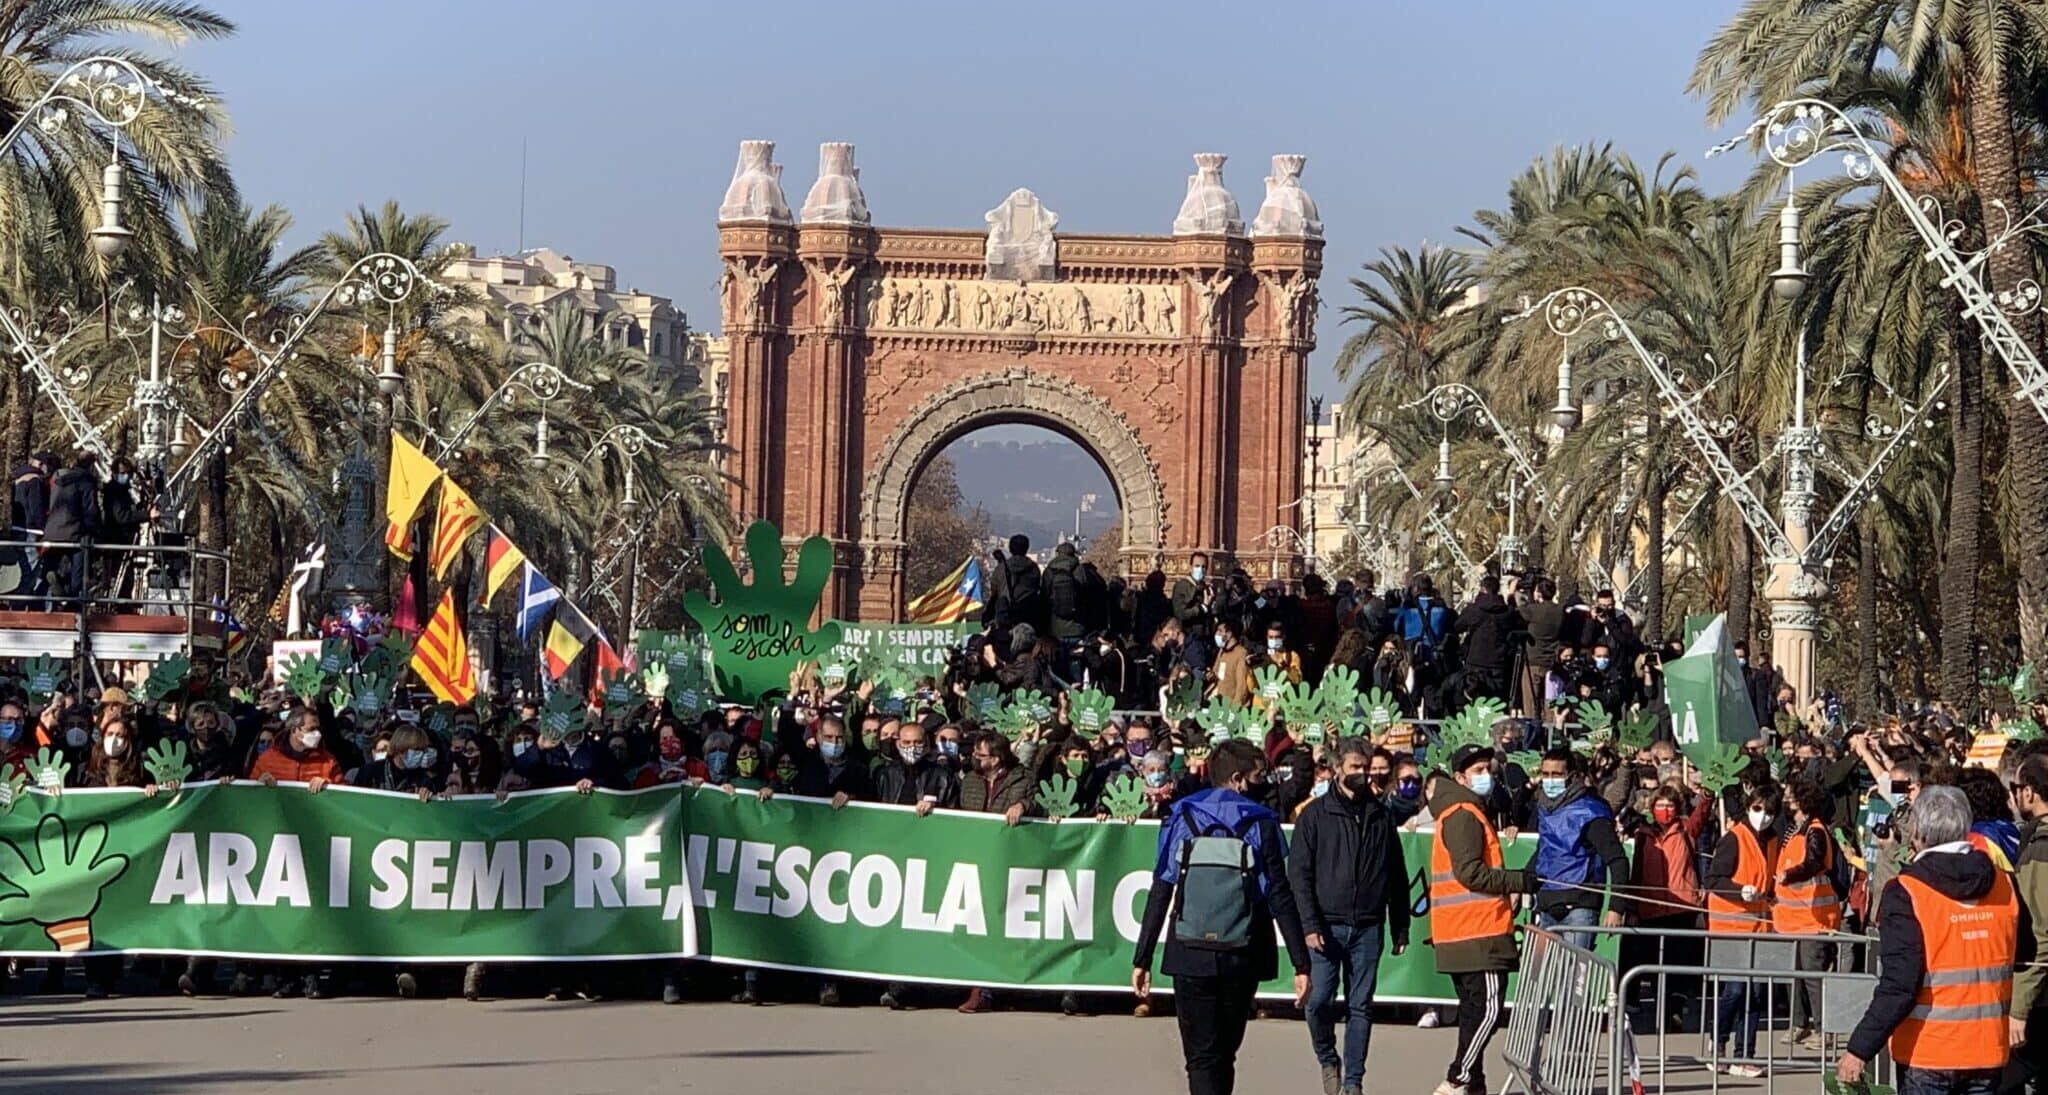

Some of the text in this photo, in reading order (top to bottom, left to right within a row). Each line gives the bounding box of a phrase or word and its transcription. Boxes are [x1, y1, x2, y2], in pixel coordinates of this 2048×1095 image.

[713, 613, 778, 639] som
[728, 620, 816, 660] escola
[150, 832, 311, 907] ARA
[329, 836, 351, 908] I
[369, 835, 687, 921] SEMPRE,
[686, 833, 988, 937] L'ESCOLA
[1004, 867, 1096, 941] EN
